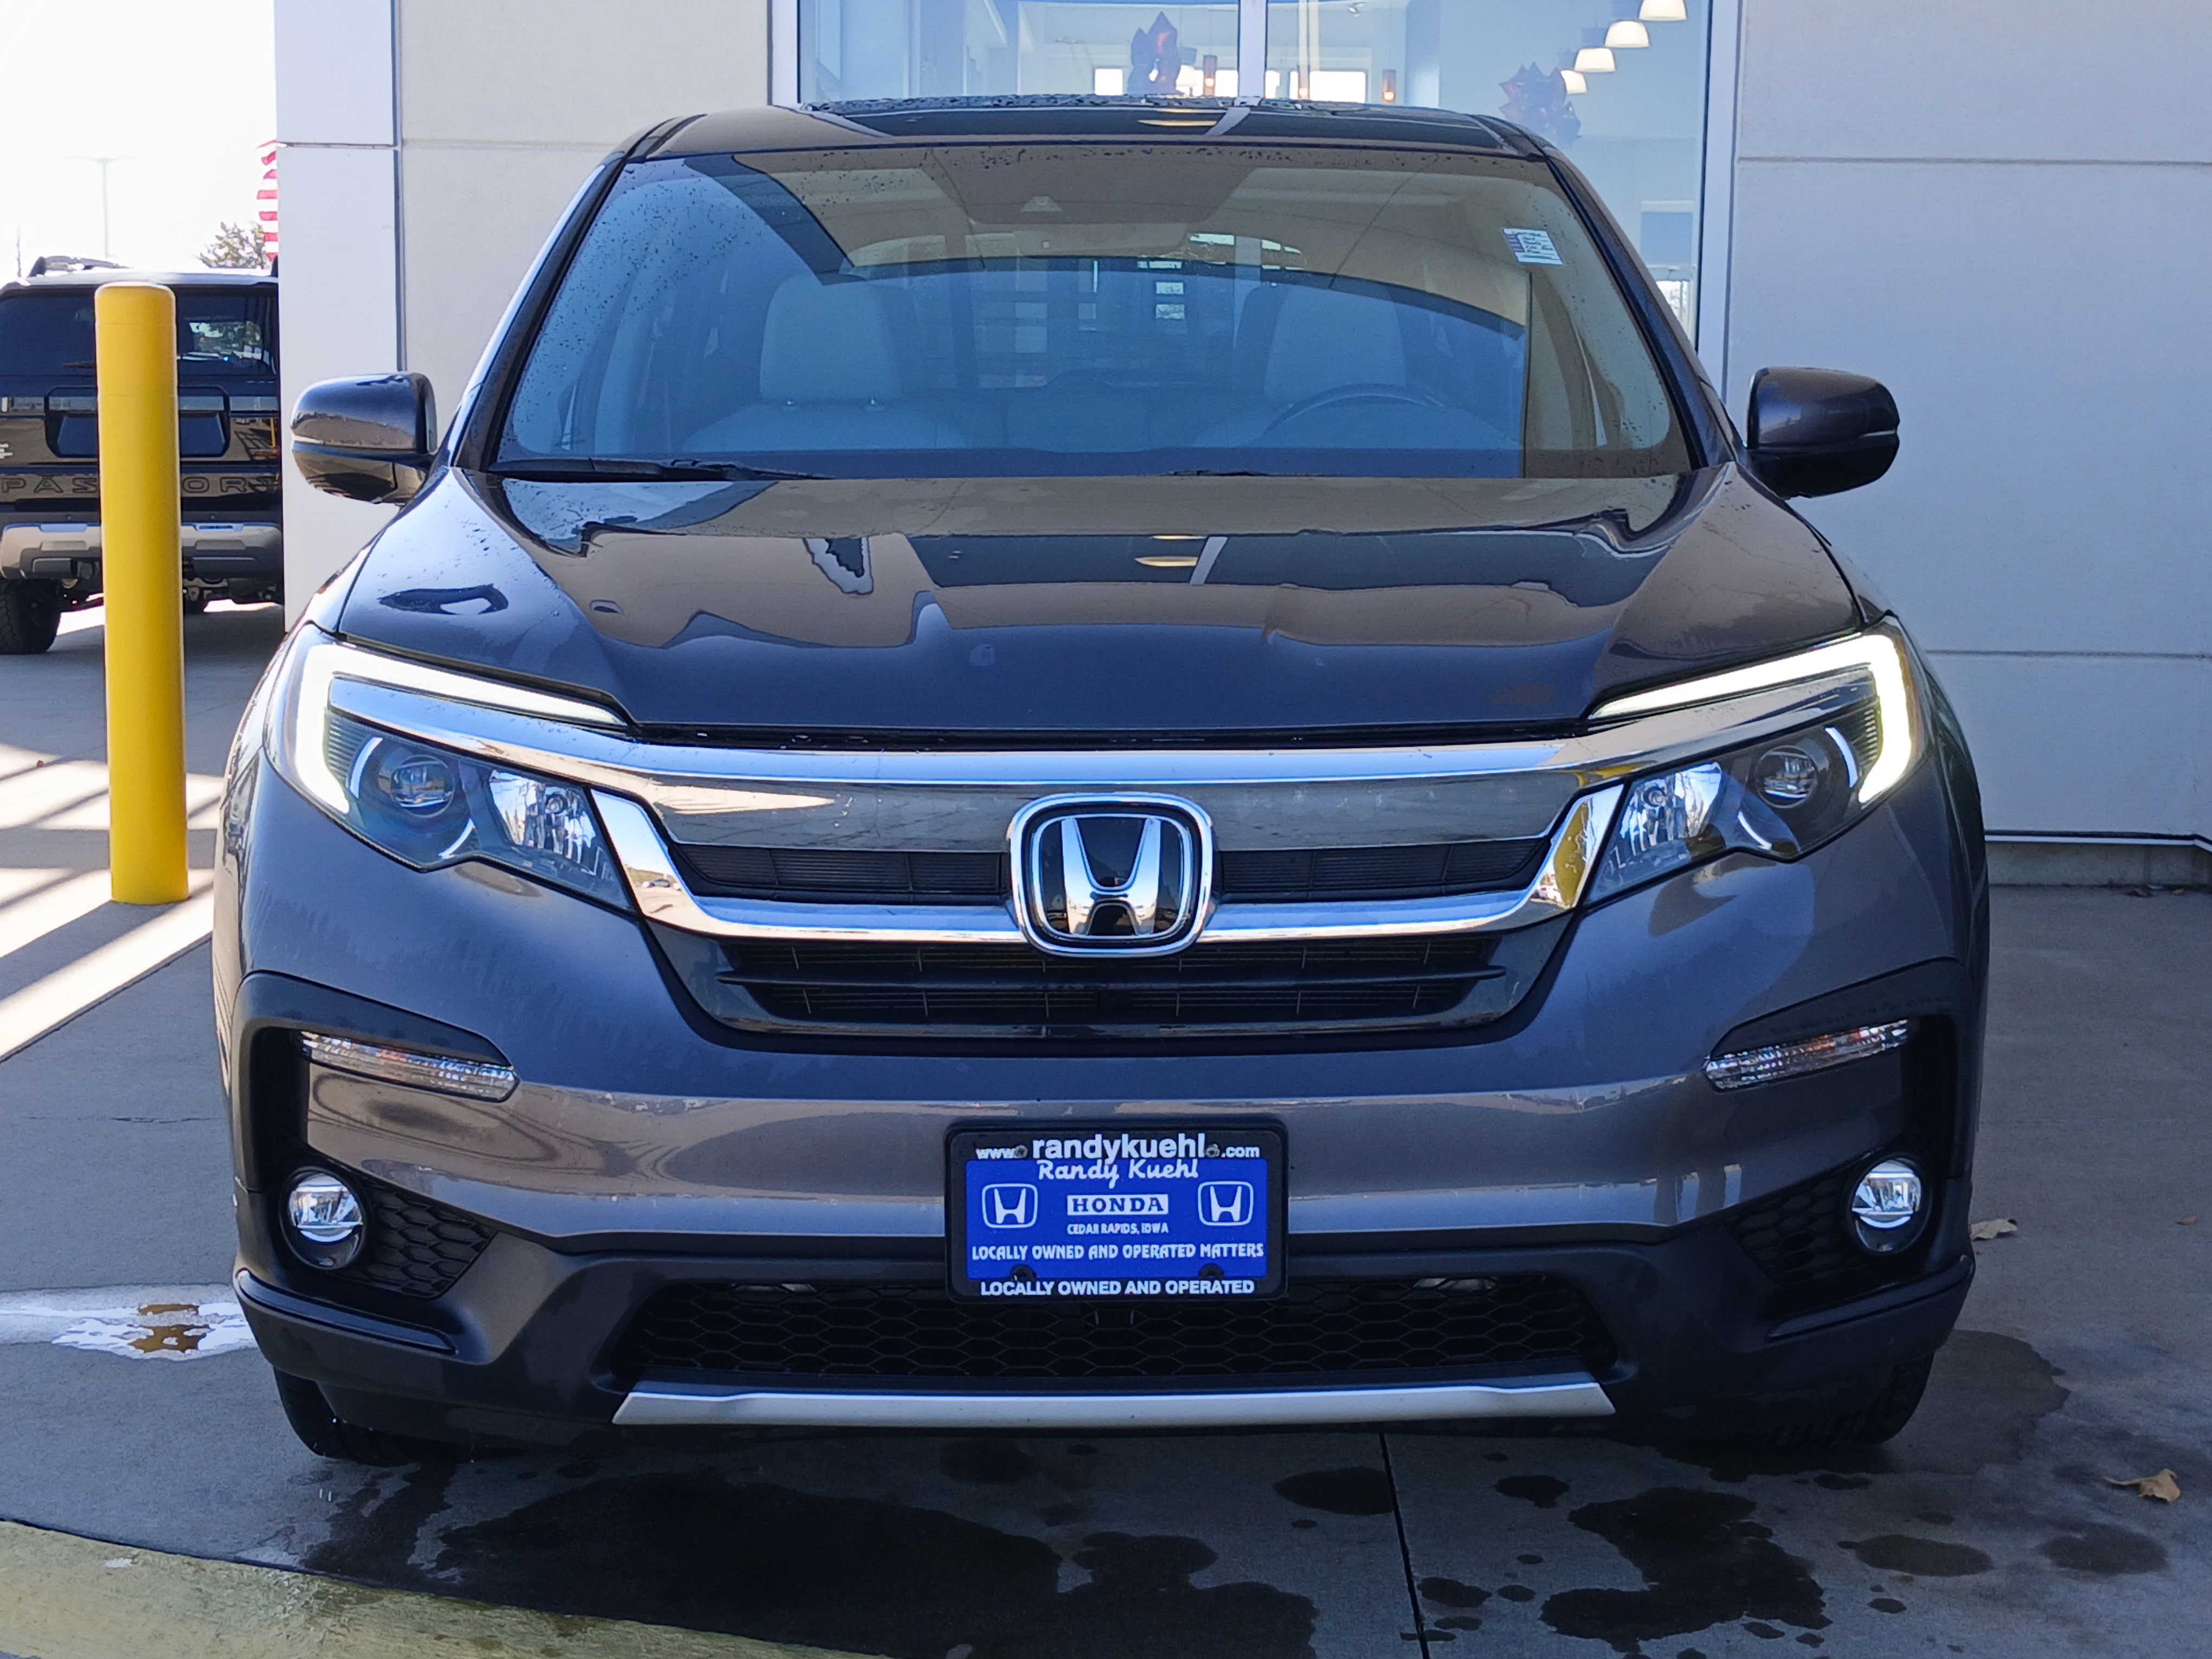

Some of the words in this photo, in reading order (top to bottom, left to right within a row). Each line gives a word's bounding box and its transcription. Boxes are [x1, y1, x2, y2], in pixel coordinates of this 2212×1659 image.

[1037, 1159, 1120, 1189] Randy
[1128, 1159, 1199, 1179] Kuehl
[1072, 1197, 1165, 1213] HONDA
[1067, 1223, 1099, 1235] CEDAR
[1141, 1222, 1169, 1234] IOWA
[972, 1245, 1028, 1261] LOCALLY
[1032, 1245, 1085, 1260] OWNED
[1088, 1244, 1119, 1260] AND
[1122, 1244, 1196, 1259] OPERATED
[1200, 1243, 1264, 1258] MATTERS
[981, 1281, 1055, 1296] LOCALLY
[1058, 1281, 1122, 1295] OWNED
[1124, 1280, 1161, 1295] AND
[1165, 1279, 1255, 1294] OPERATED
